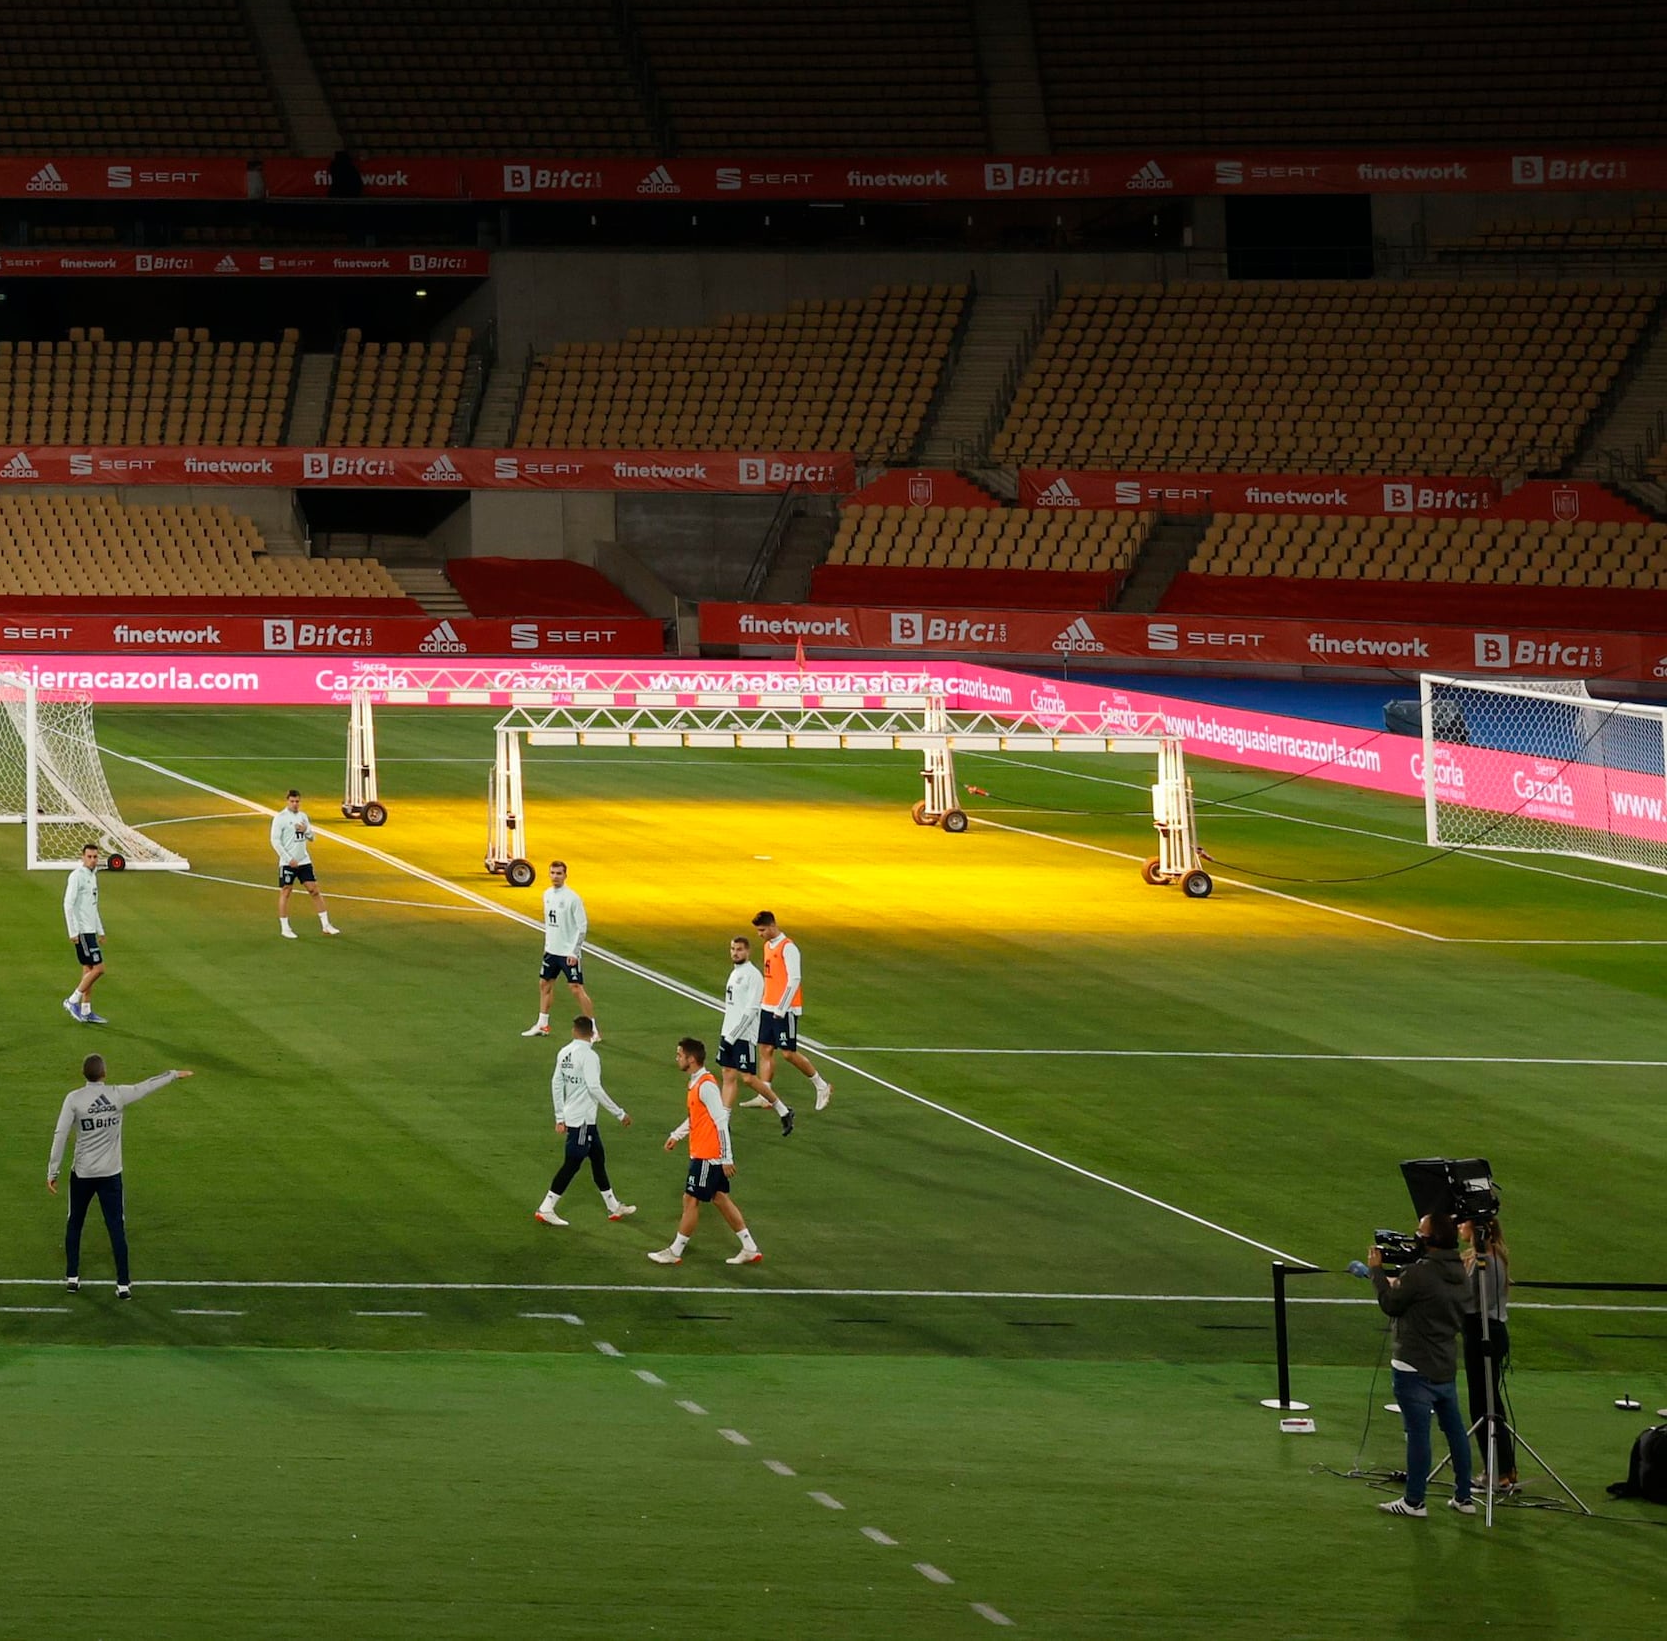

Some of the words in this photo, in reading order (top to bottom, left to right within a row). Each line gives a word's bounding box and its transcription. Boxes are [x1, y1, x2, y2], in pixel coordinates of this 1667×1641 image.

[750, 174, 812, 183] SEAT
[847, 170, 947, 186] finetwork
[99, 460, 155, 469] SEAT
[185, 458, 272, 472] finetwork
[614, 462, 706, 478] finetwork
[1148, 488, 1213, 499] SEAT
[1245, 488, 1348, 506] finetwork
[739, 615, 849, 635] finetwork
[4, 628, 72, 639] SEAT
[114, 625, 220, 643] finetwork
[547, 631, 616, 641] SEAT
[1188, 633, 1264, 646] SEAT
[419, 639, 467, 652] adidas
[1053, 640, 1104, 652] adidas
[1307, 633, 1429, 657] finetwork
